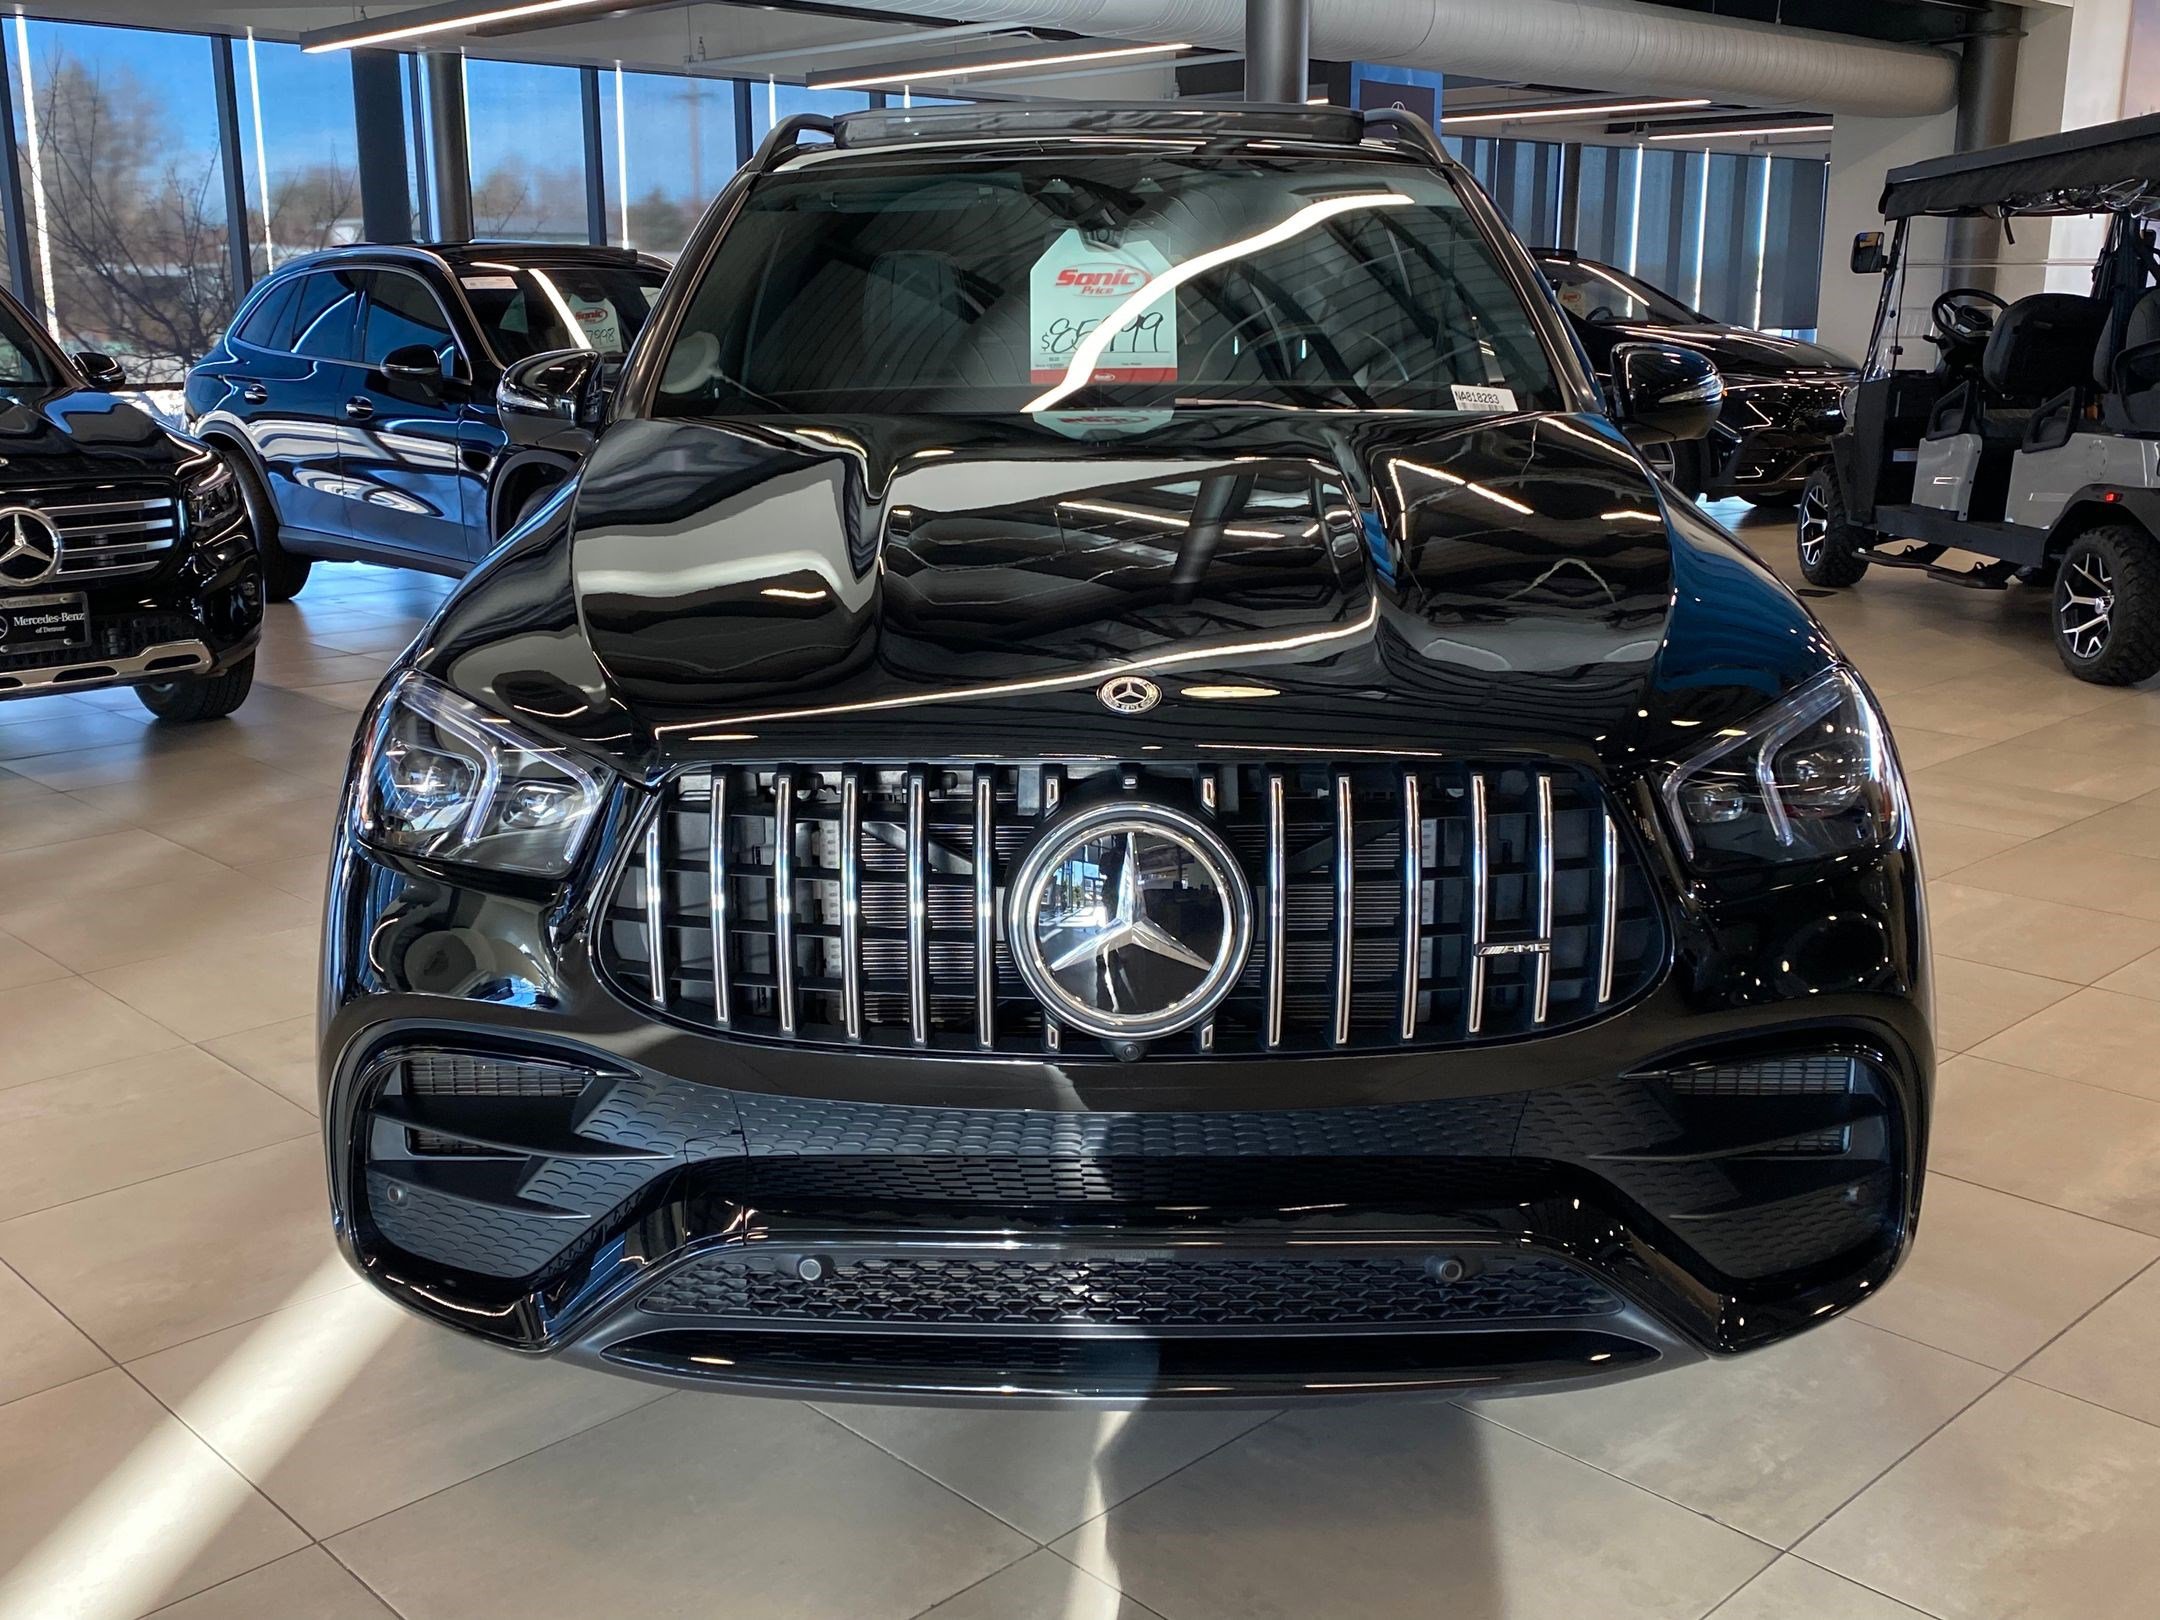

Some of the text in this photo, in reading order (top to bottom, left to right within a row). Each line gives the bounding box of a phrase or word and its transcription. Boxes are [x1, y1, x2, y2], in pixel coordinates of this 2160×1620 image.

[1055, 268, 1138, 286] Sonic
[1082, 286, 1114, 294] Price
[13, 612, 85, 627] Mercedes-Benz
[1505, 943, 1551, 953] AMG
